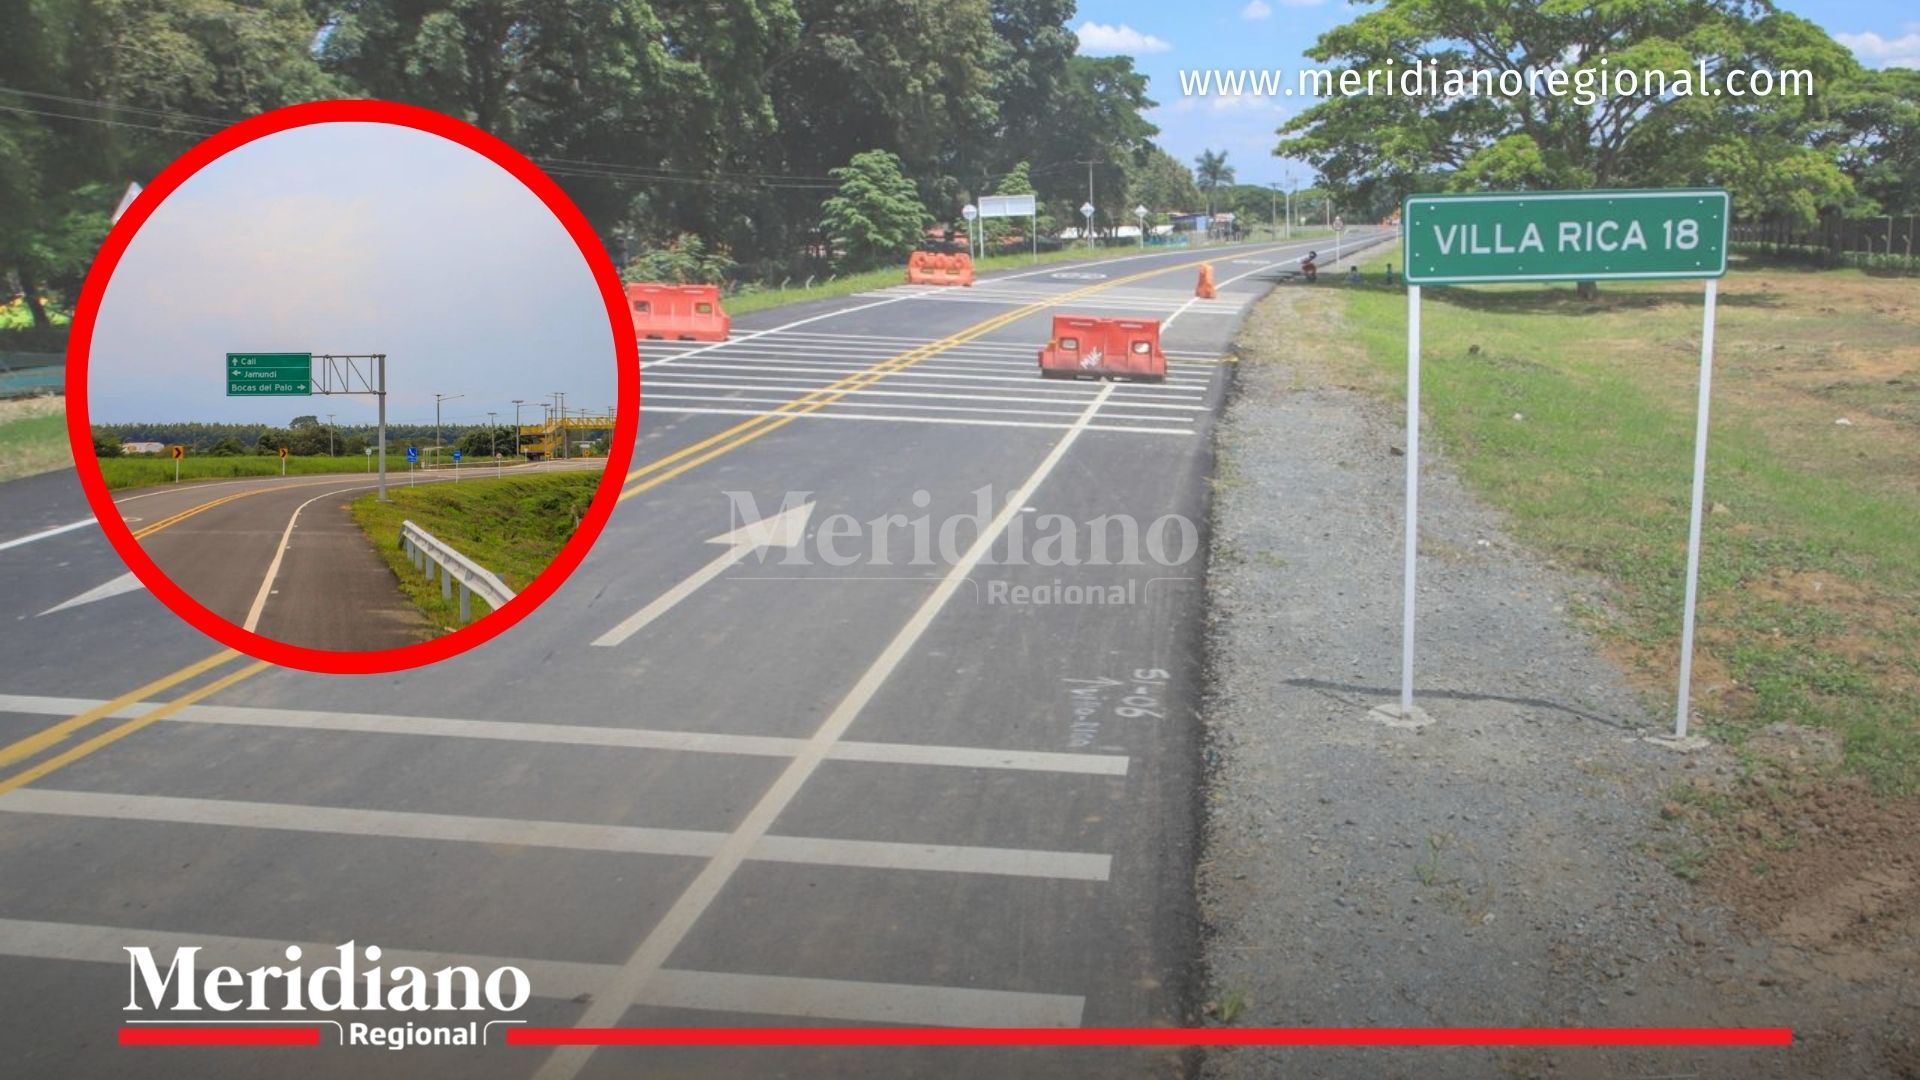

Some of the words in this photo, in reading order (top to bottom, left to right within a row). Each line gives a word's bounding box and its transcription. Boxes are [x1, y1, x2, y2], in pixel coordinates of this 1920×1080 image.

[1434, 221, 1544, 256] VILLA
[1558, 219, 1647, 252] RICA
[1662, 218, 1700, 250] 18
[241, 357, 257, 365] Cali
[231, 384, 257, 392] Bocas
[259, 384, 272, 392] del
[274, 384, 293, 392] Palo
